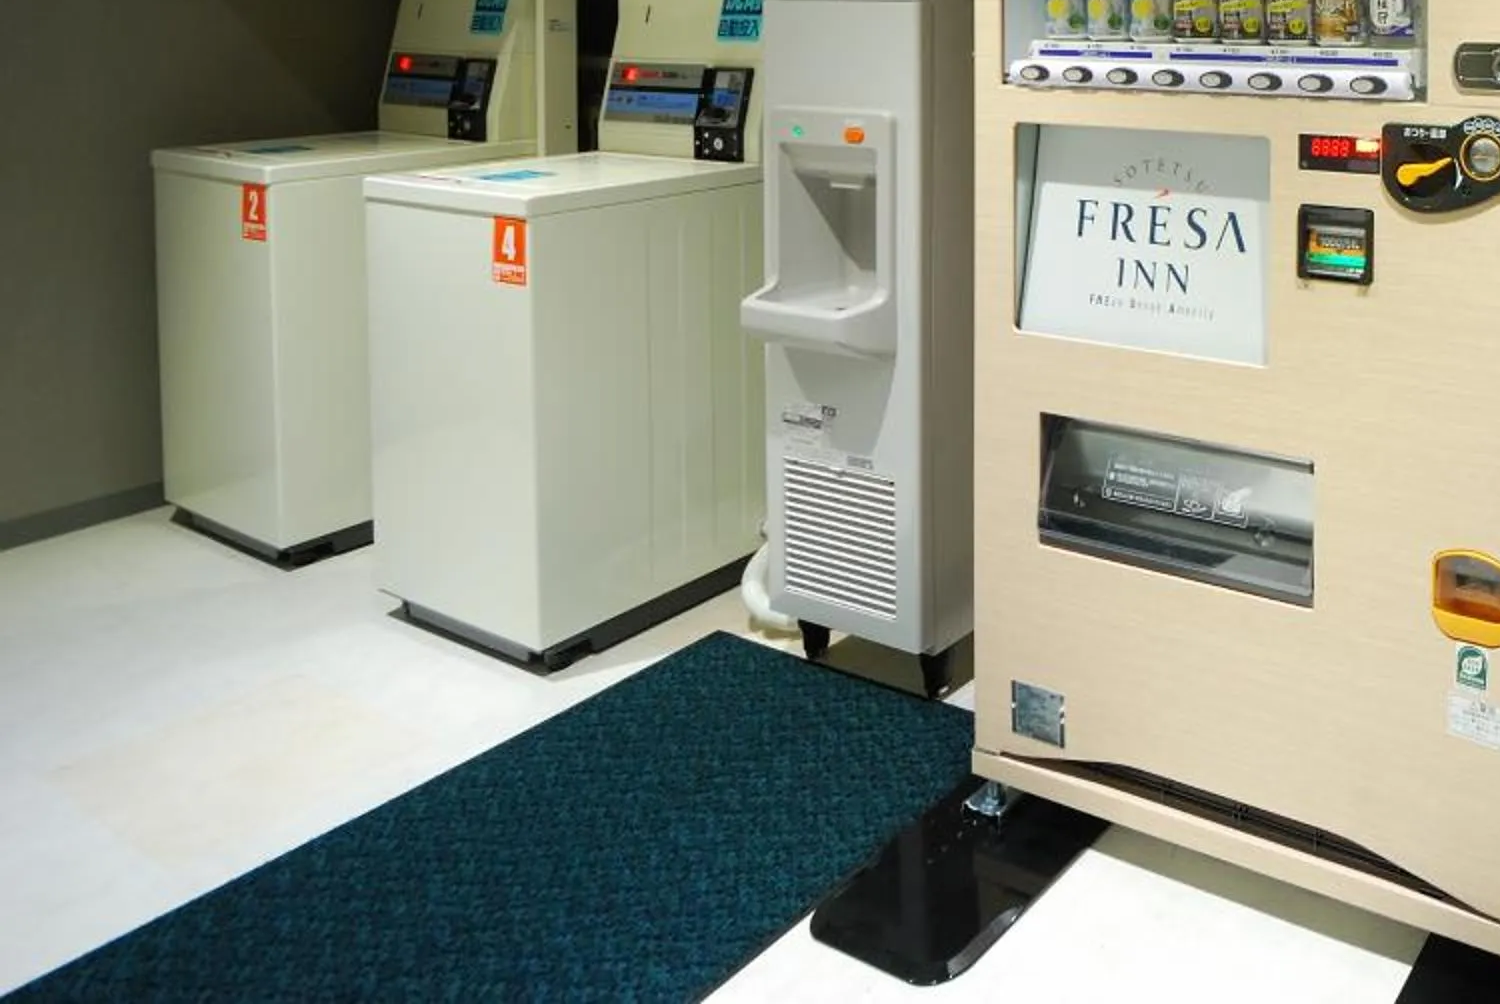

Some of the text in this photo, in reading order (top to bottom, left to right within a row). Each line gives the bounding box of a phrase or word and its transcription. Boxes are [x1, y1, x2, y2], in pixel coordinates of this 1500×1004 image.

[1111, 157, 1214, 194] SOTETSU
[248, 190, 259, 221] 2
[501, 225, 516, 261] 4
[1117, 258, 1189, 295] INN
